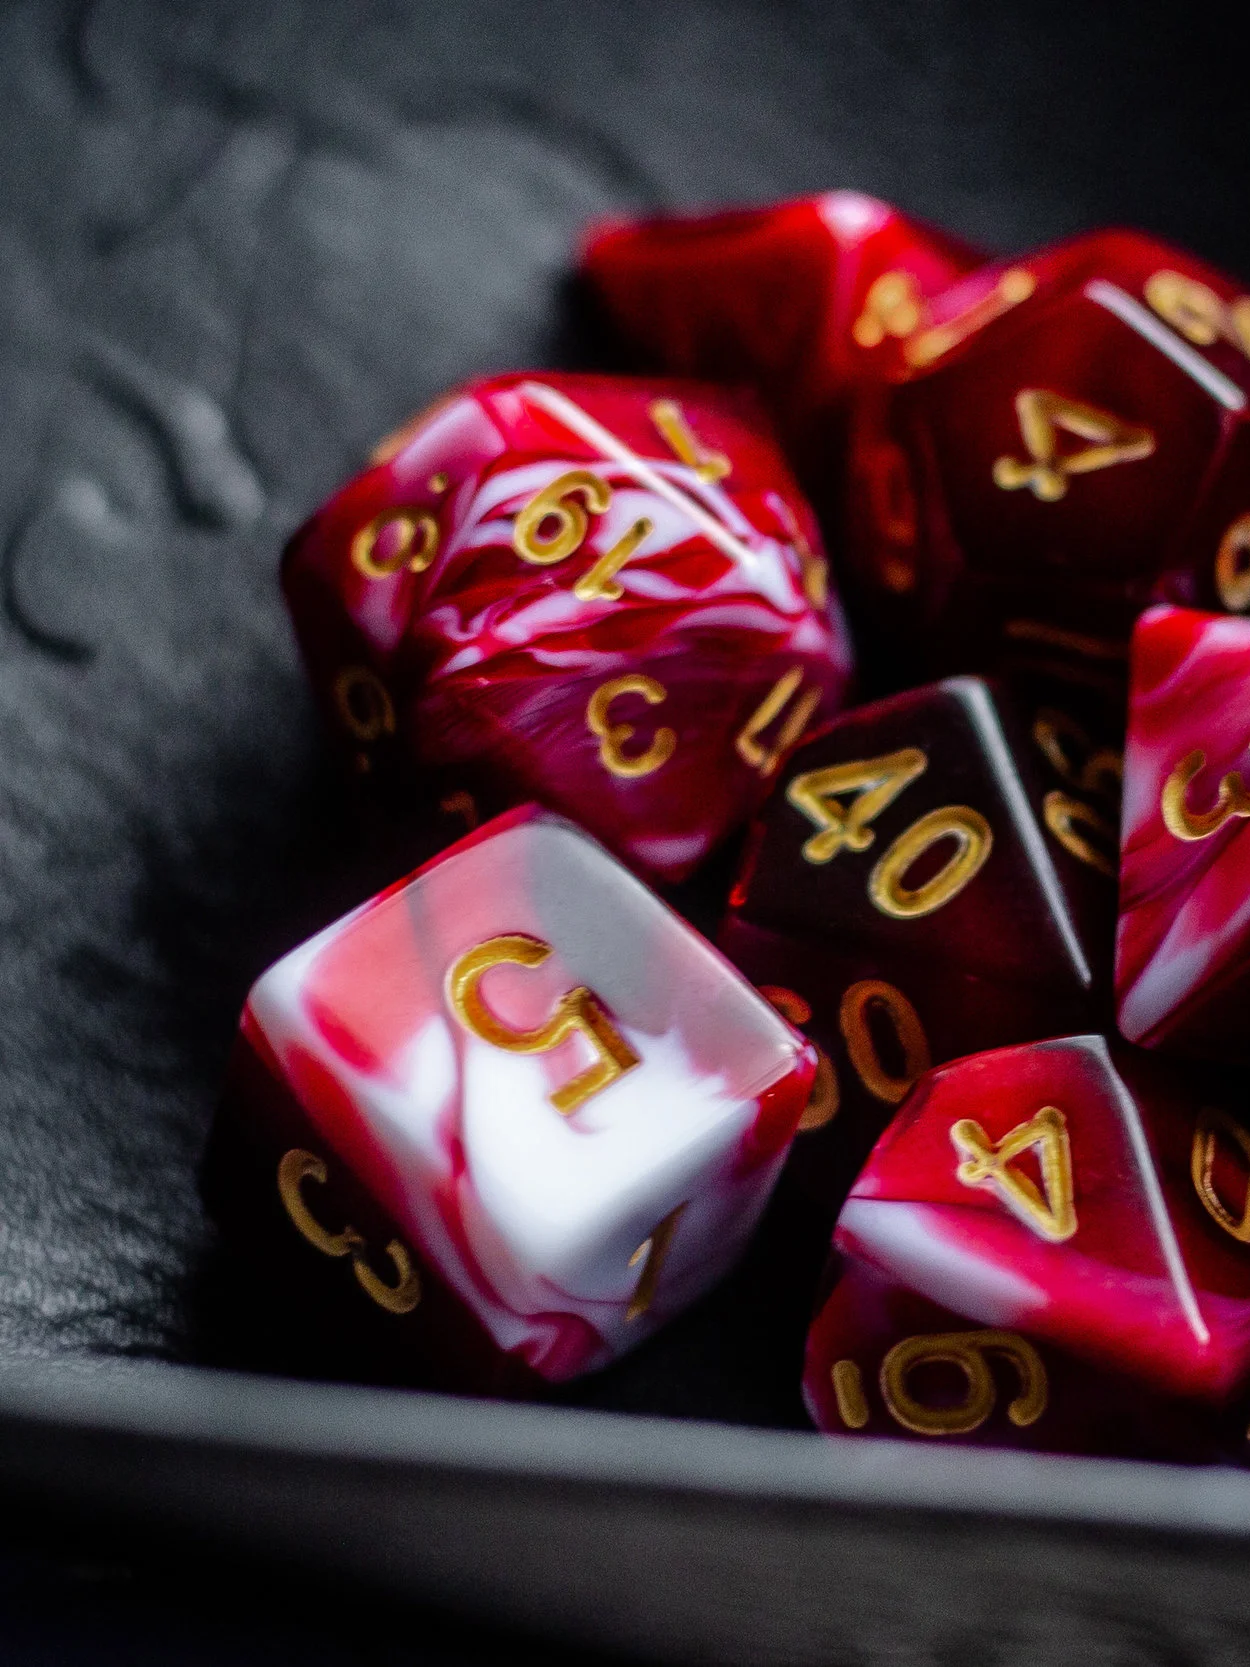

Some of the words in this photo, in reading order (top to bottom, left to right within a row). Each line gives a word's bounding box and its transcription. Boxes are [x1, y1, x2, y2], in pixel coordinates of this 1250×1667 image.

[992, 388, 1157, 502] 4
[585, 673, 677, 780] 3
[785, 746, 995, 922] 40
[444, 932, 643, 1116] 5
[276, 1147, 423, 1316] 3
[949, 1105, 1078, 1245] 4
